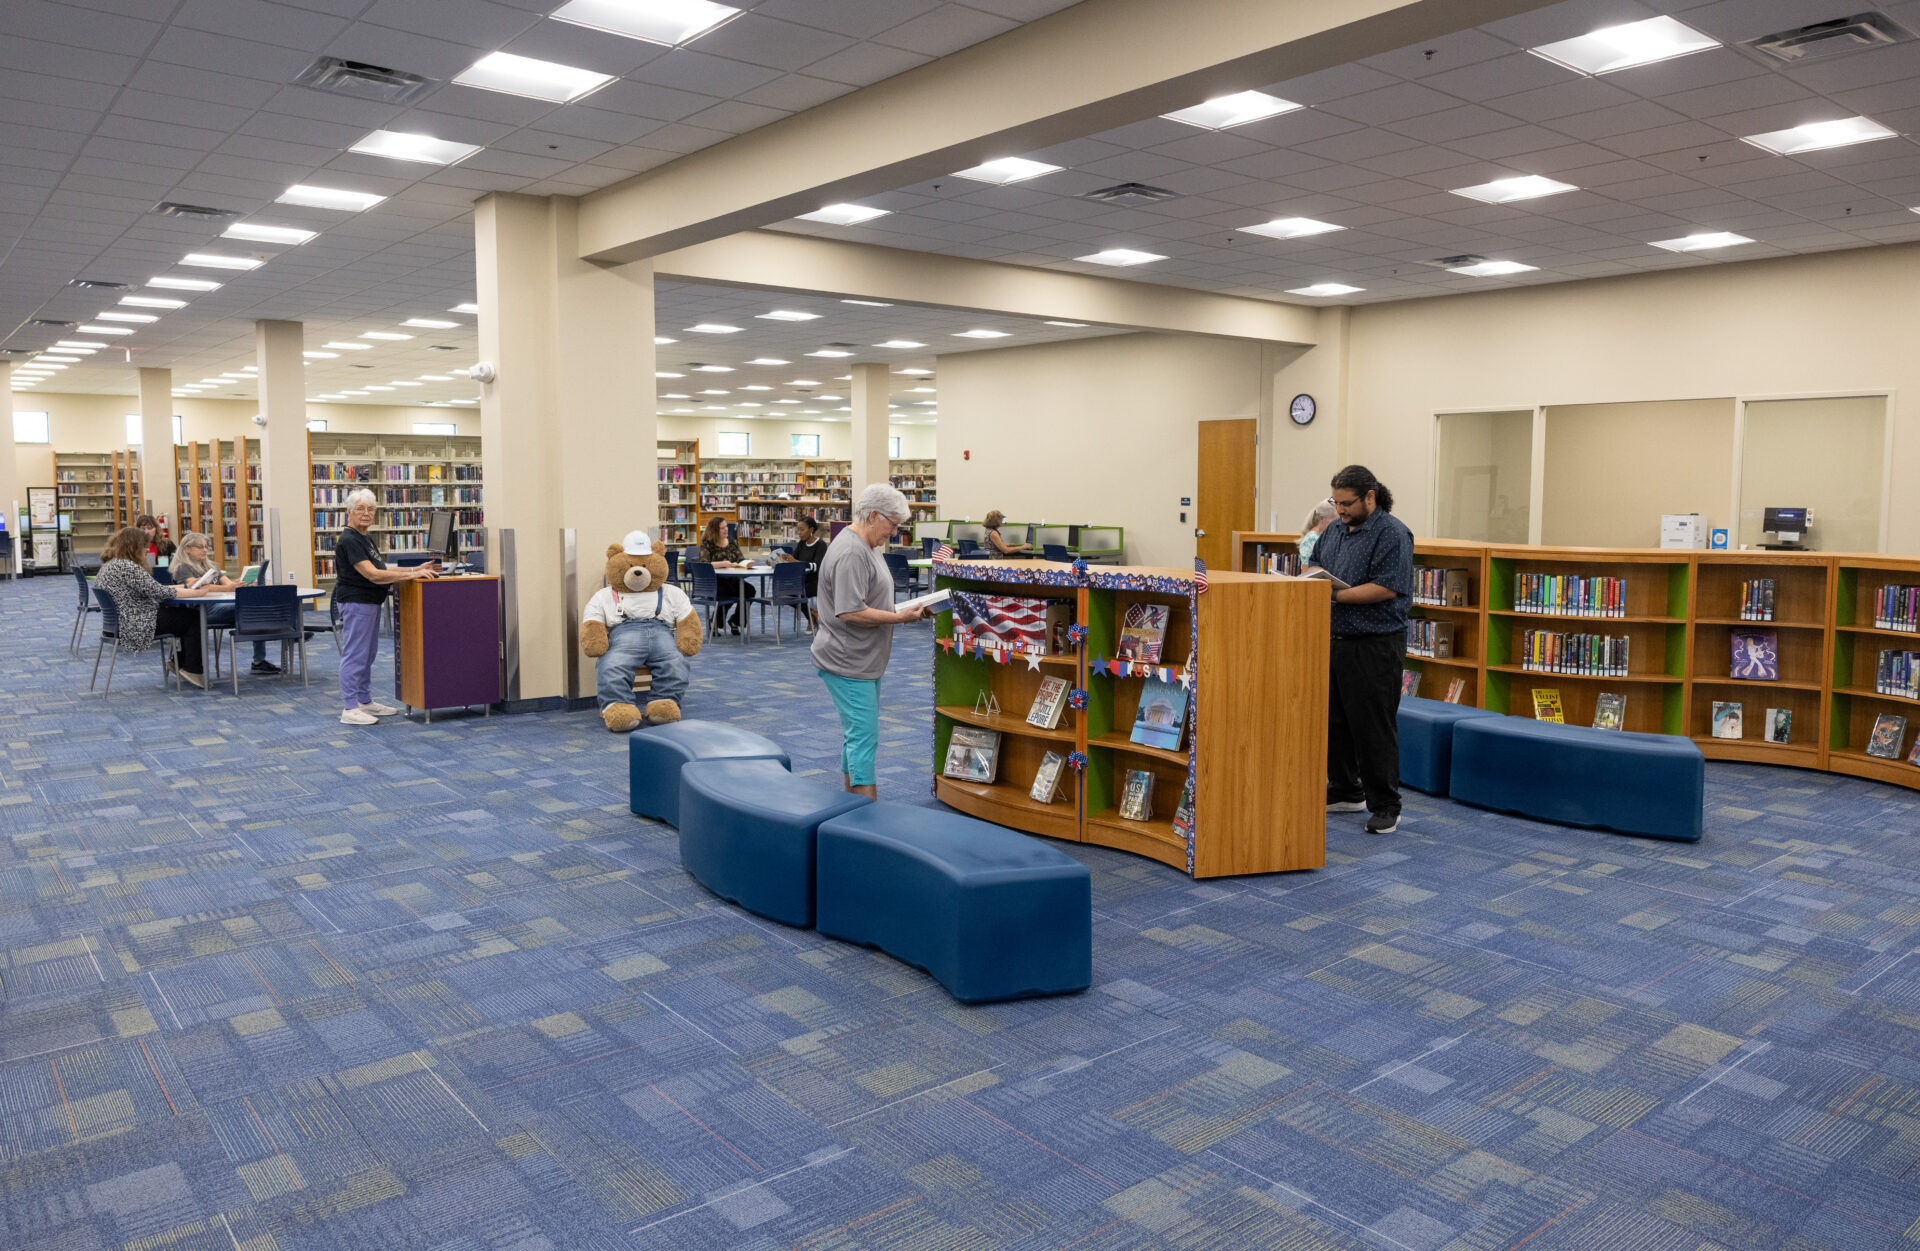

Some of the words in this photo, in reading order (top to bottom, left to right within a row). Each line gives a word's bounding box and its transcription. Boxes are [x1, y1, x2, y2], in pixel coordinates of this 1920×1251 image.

[394, 591, 400, 613] UP
[1135, 663, 1158, 678] USA
[1041, 680, 1053, 690] WE
[1051, 682, 1063, 693] THE
[1038, 690, 1059, 703] PEOPLE
[1027, 713, 1049, 726] LEPORE
[1130, 783, 1145, 794] USA
